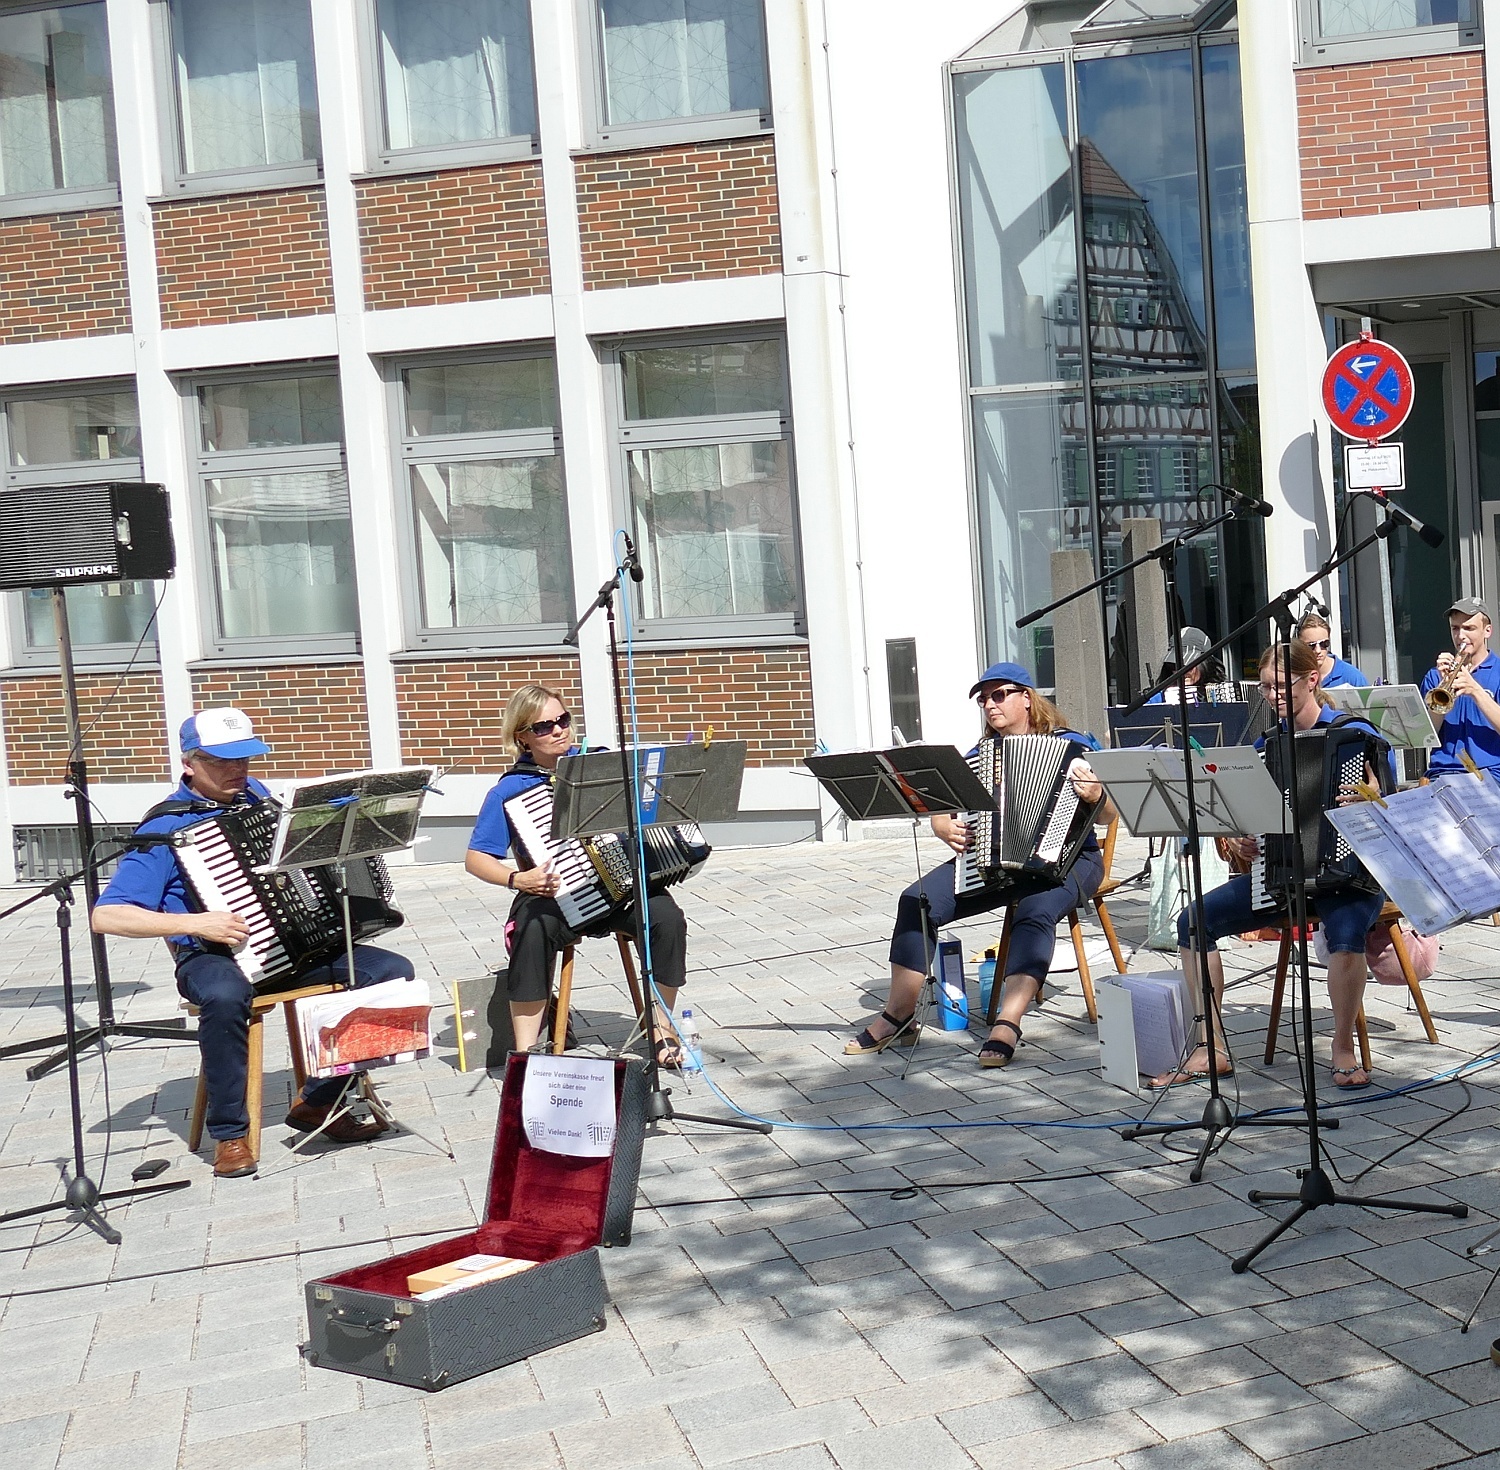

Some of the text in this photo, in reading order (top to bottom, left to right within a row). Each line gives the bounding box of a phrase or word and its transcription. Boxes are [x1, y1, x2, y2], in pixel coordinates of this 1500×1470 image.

[55, 565, 113, 578] SUPREM
[532, 1070, 605, 1082] Unsere Vereinskasse freut
[562, 1083, 574, 1091] über
[550, 1095, 583, 1108] Spende
[548, 1128, 582, 1138] Vielen Dank!
